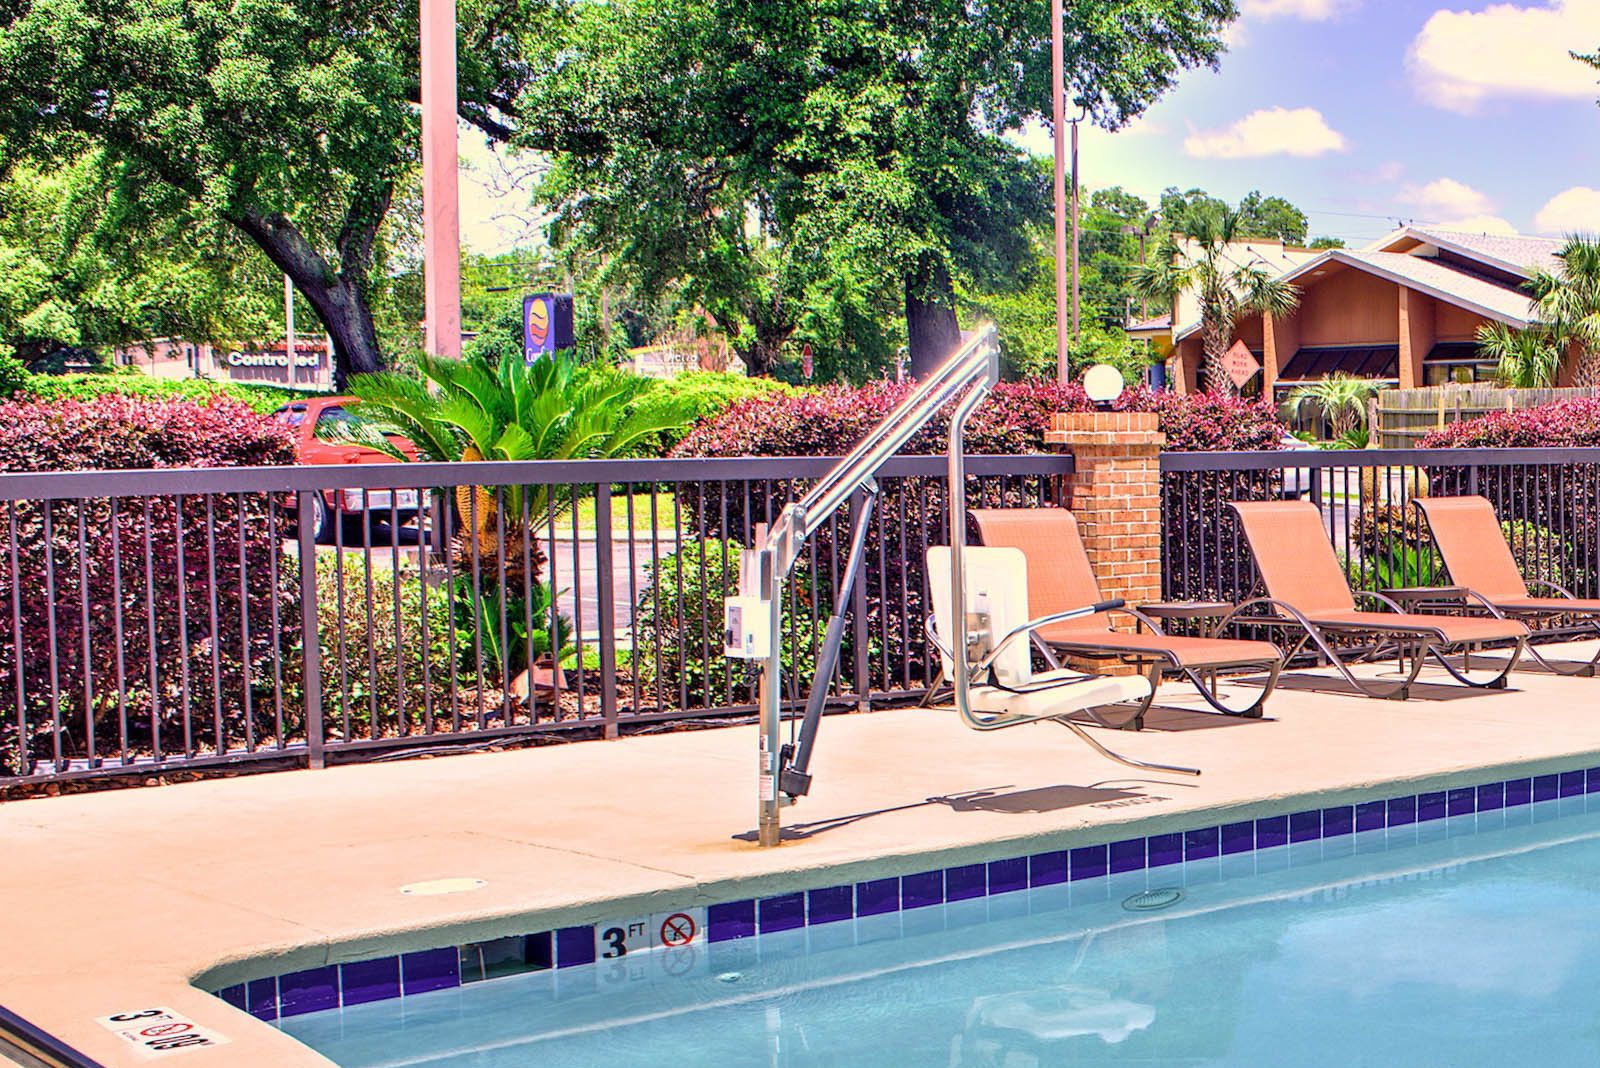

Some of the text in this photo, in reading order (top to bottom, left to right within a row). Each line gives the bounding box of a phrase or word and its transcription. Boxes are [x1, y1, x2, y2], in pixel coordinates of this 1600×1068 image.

[228, 352, 319, 367] Controled
[602, 922, 646, 959] 3 FT
[108, 1010, 164, 1022] 3
